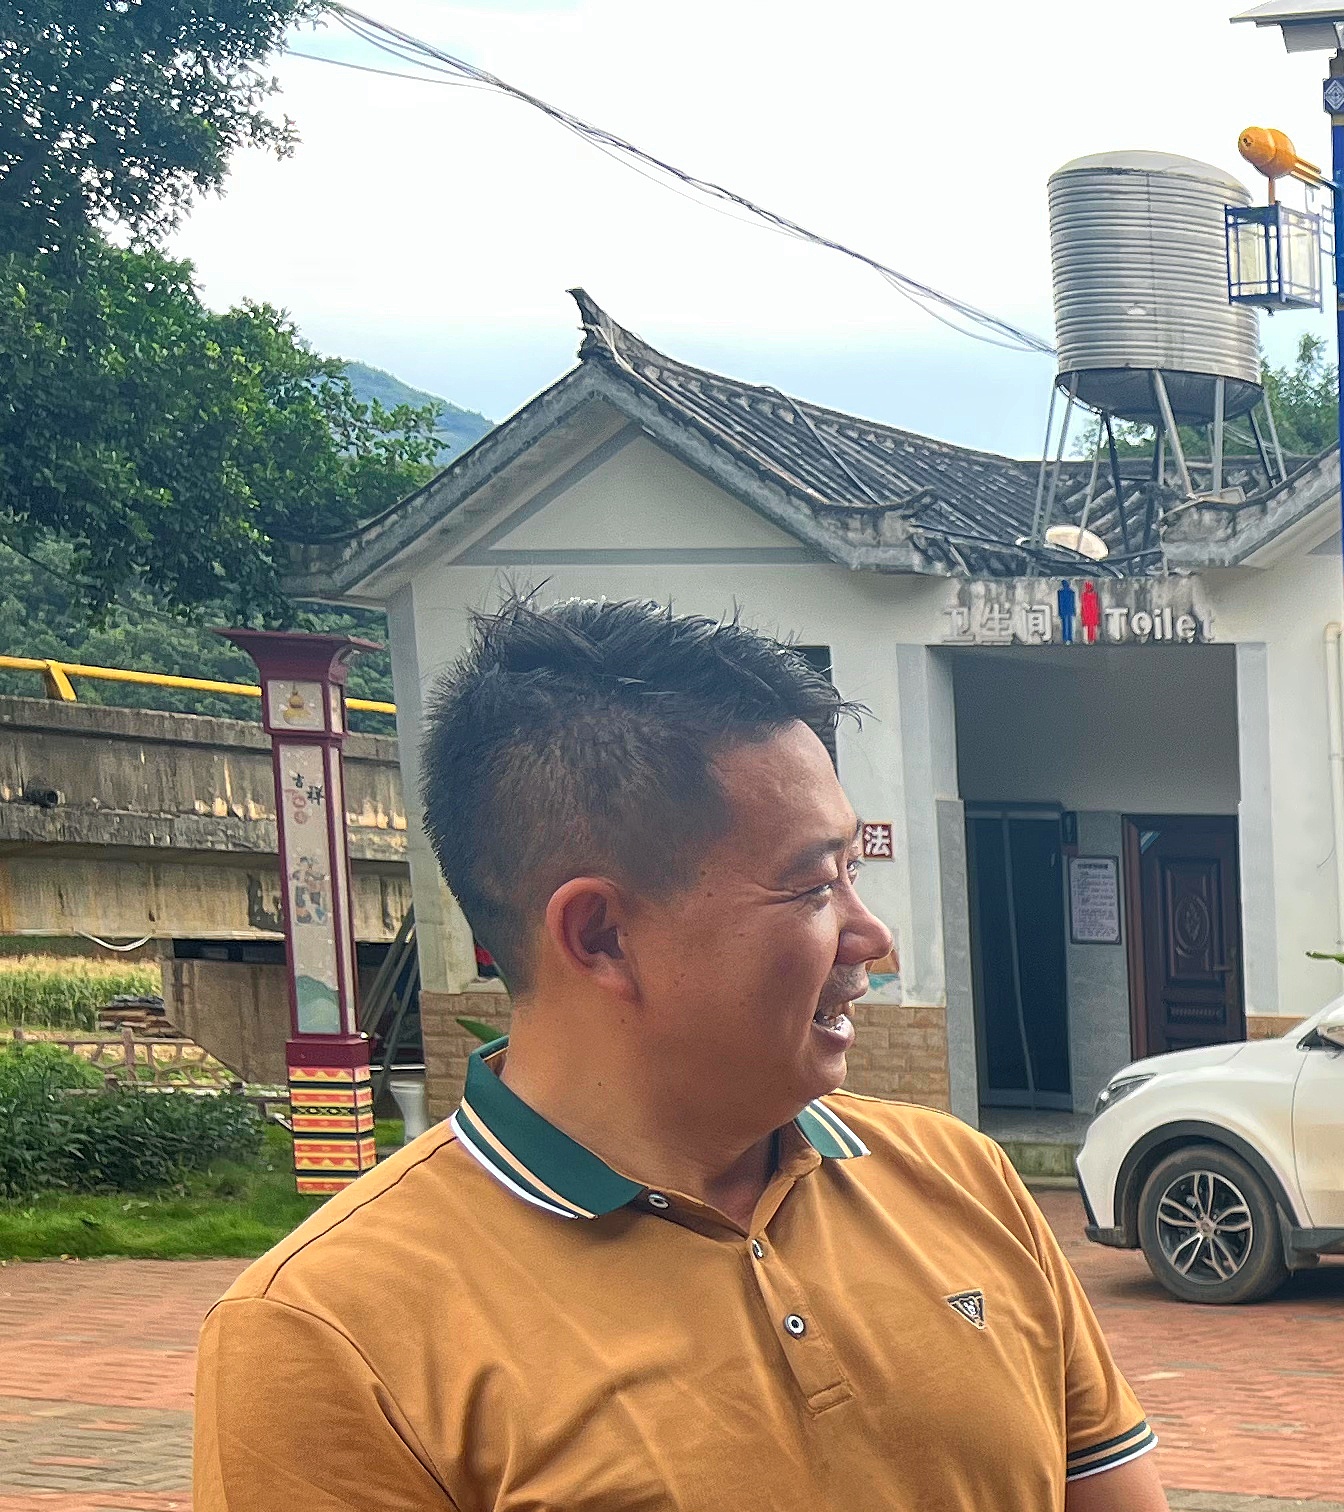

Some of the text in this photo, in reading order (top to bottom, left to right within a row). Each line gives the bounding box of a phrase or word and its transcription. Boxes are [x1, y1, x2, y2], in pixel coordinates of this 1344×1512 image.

[942, 603, 1053, 645] 卫生间
[1104, 607, 1217, 643] Toilet
[292, 774, 325, 805] 吉祥
[864, 825, 891, 857] 法
